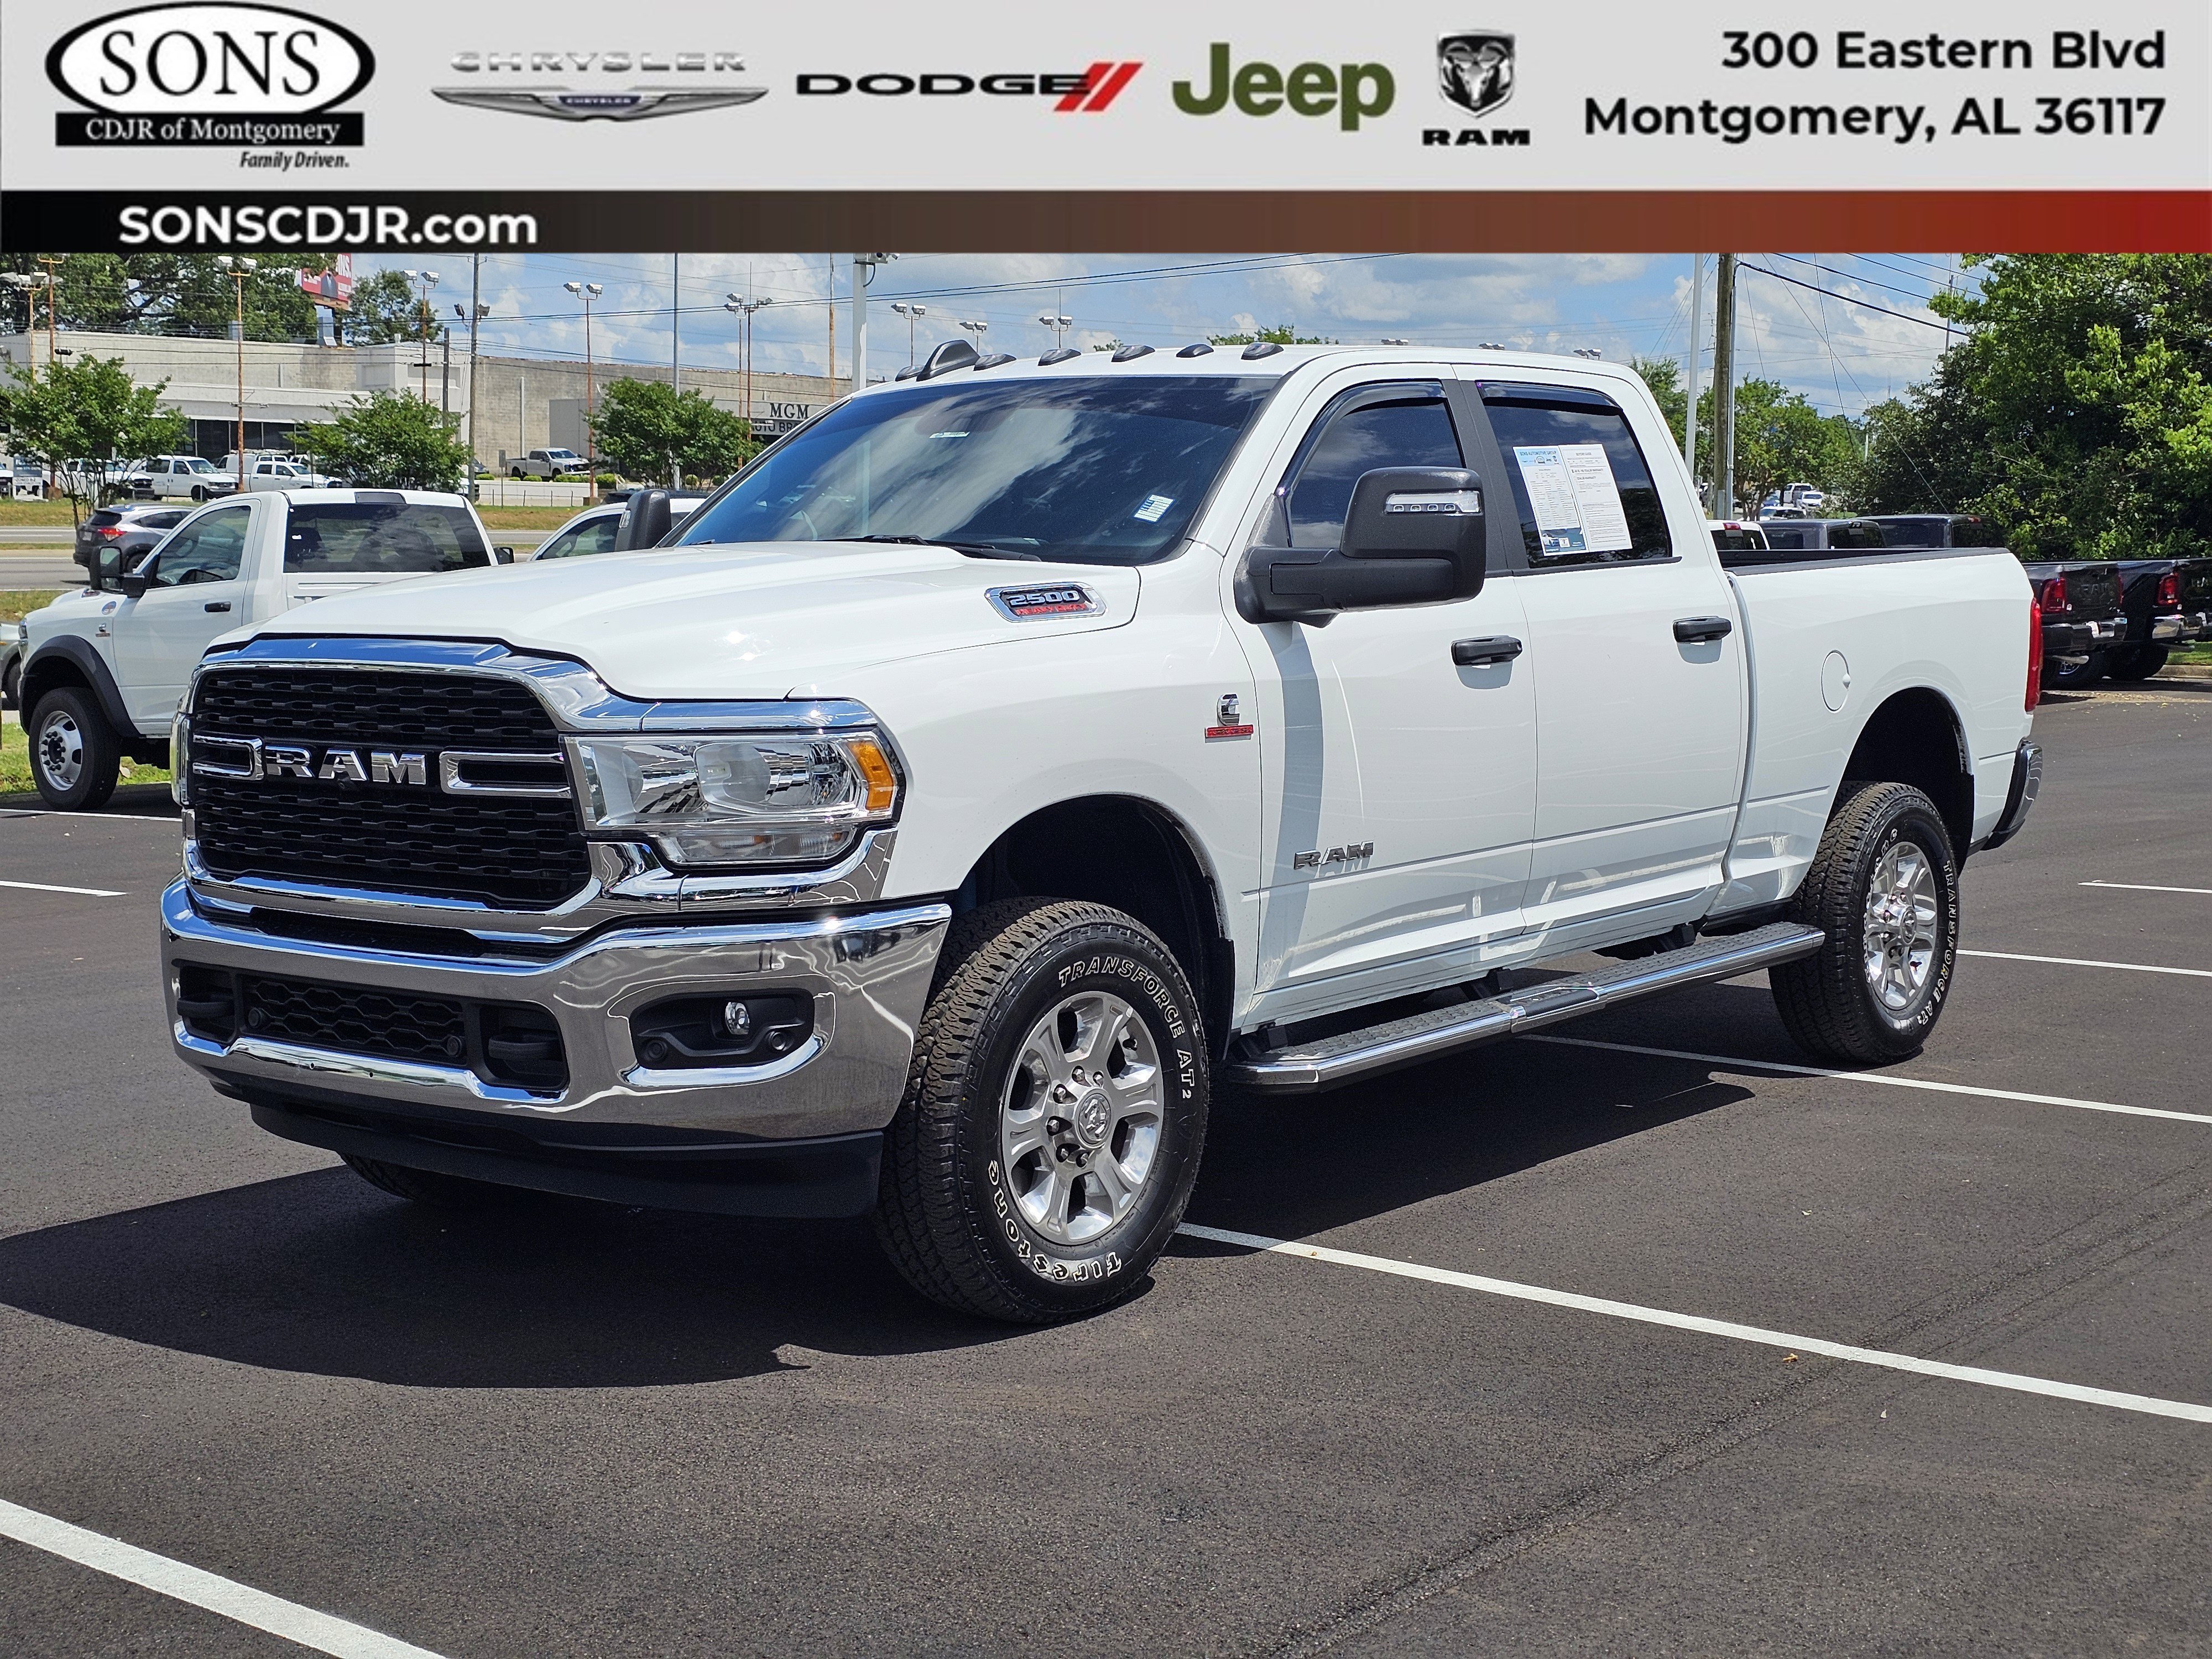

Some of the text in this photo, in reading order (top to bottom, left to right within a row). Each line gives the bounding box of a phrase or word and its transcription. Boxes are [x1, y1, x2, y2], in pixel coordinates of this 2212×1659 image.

[769, 403, 810, 419] MGM
[751, 421, 800, 432] UTO BR
[1006, 590, 1079, 608] 2500
[265, 745, 426, 785] RAM
[1293, 840, 1374, 870] RAM
[1058, 956, 1186, 1040] TRANSFORCE
